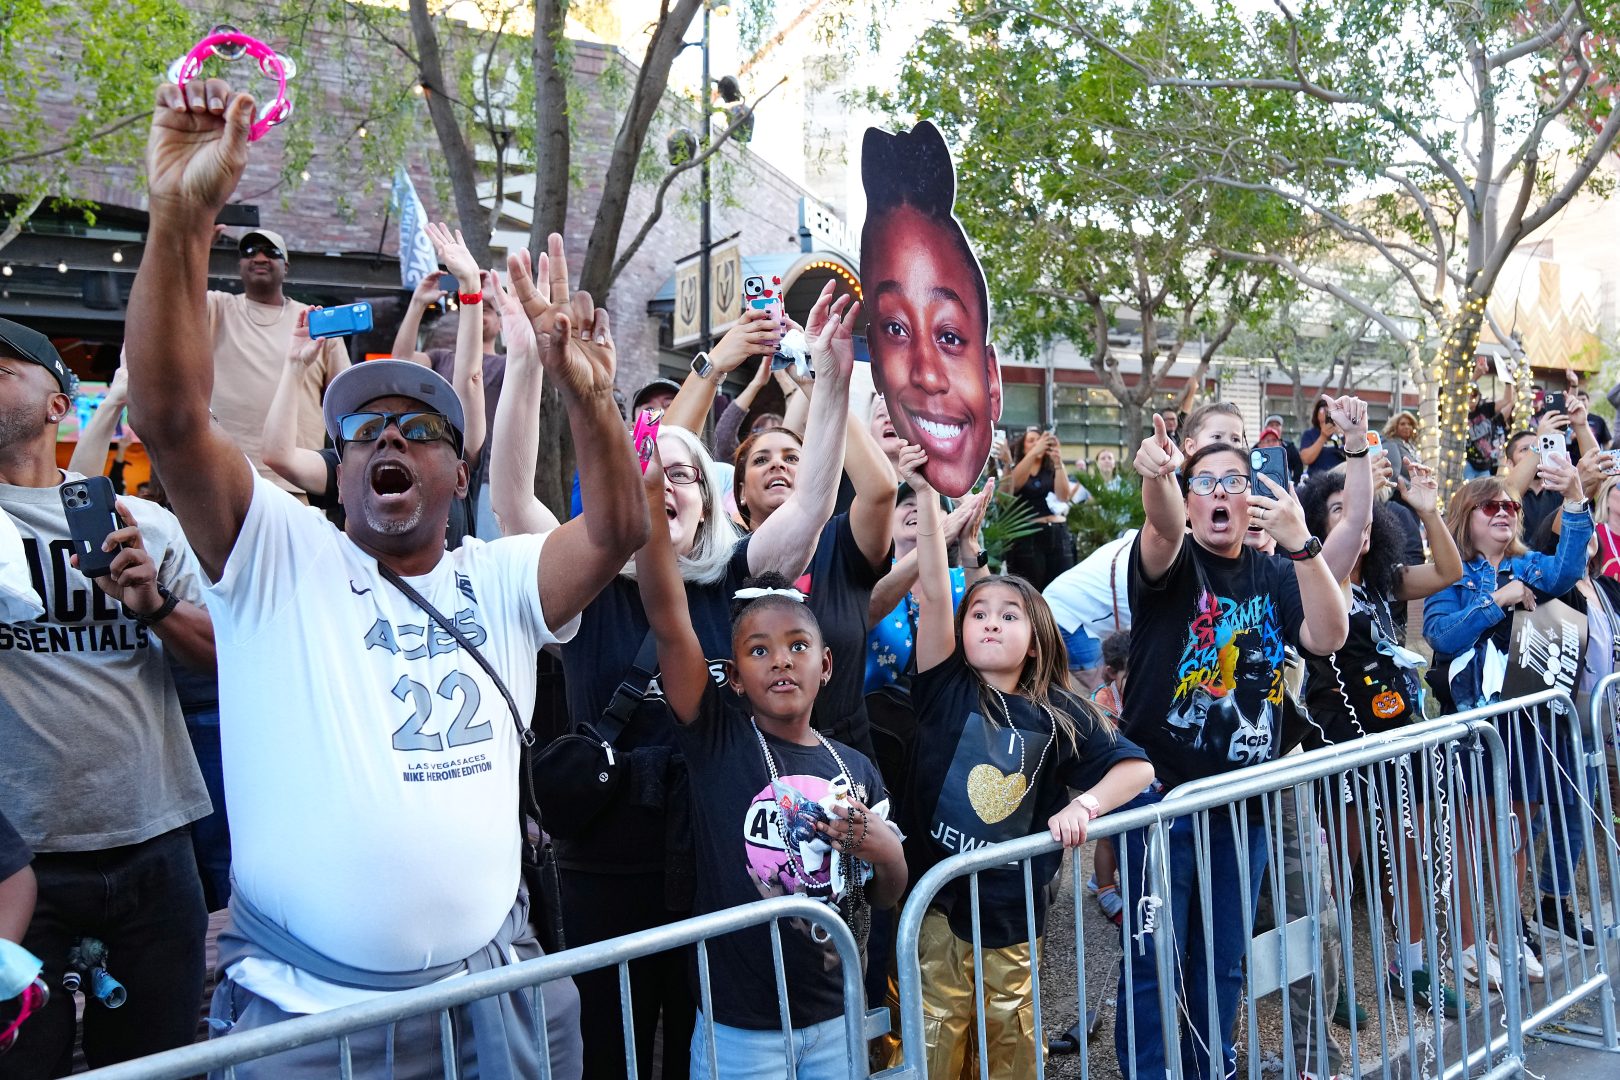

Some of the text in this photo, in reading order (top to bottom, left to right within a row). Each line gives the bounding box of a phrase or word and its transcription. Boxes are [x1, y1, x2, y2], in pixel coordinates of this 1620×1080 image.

[364, 608, 488, 660] ACES
[1561, 619, 1579, 660] THREE
[1560, 654, 1578, 677] OF
[1557, 672, 1575, 686] A
[391, 669, 493, 752] 22
[1007, 733, 1016, 755] I
[403, 761, 492, 782] NIKE HEROINE EDITION
[431, 757, 462, 770] VEGAS
[462, 754, 486, 764] ACES
